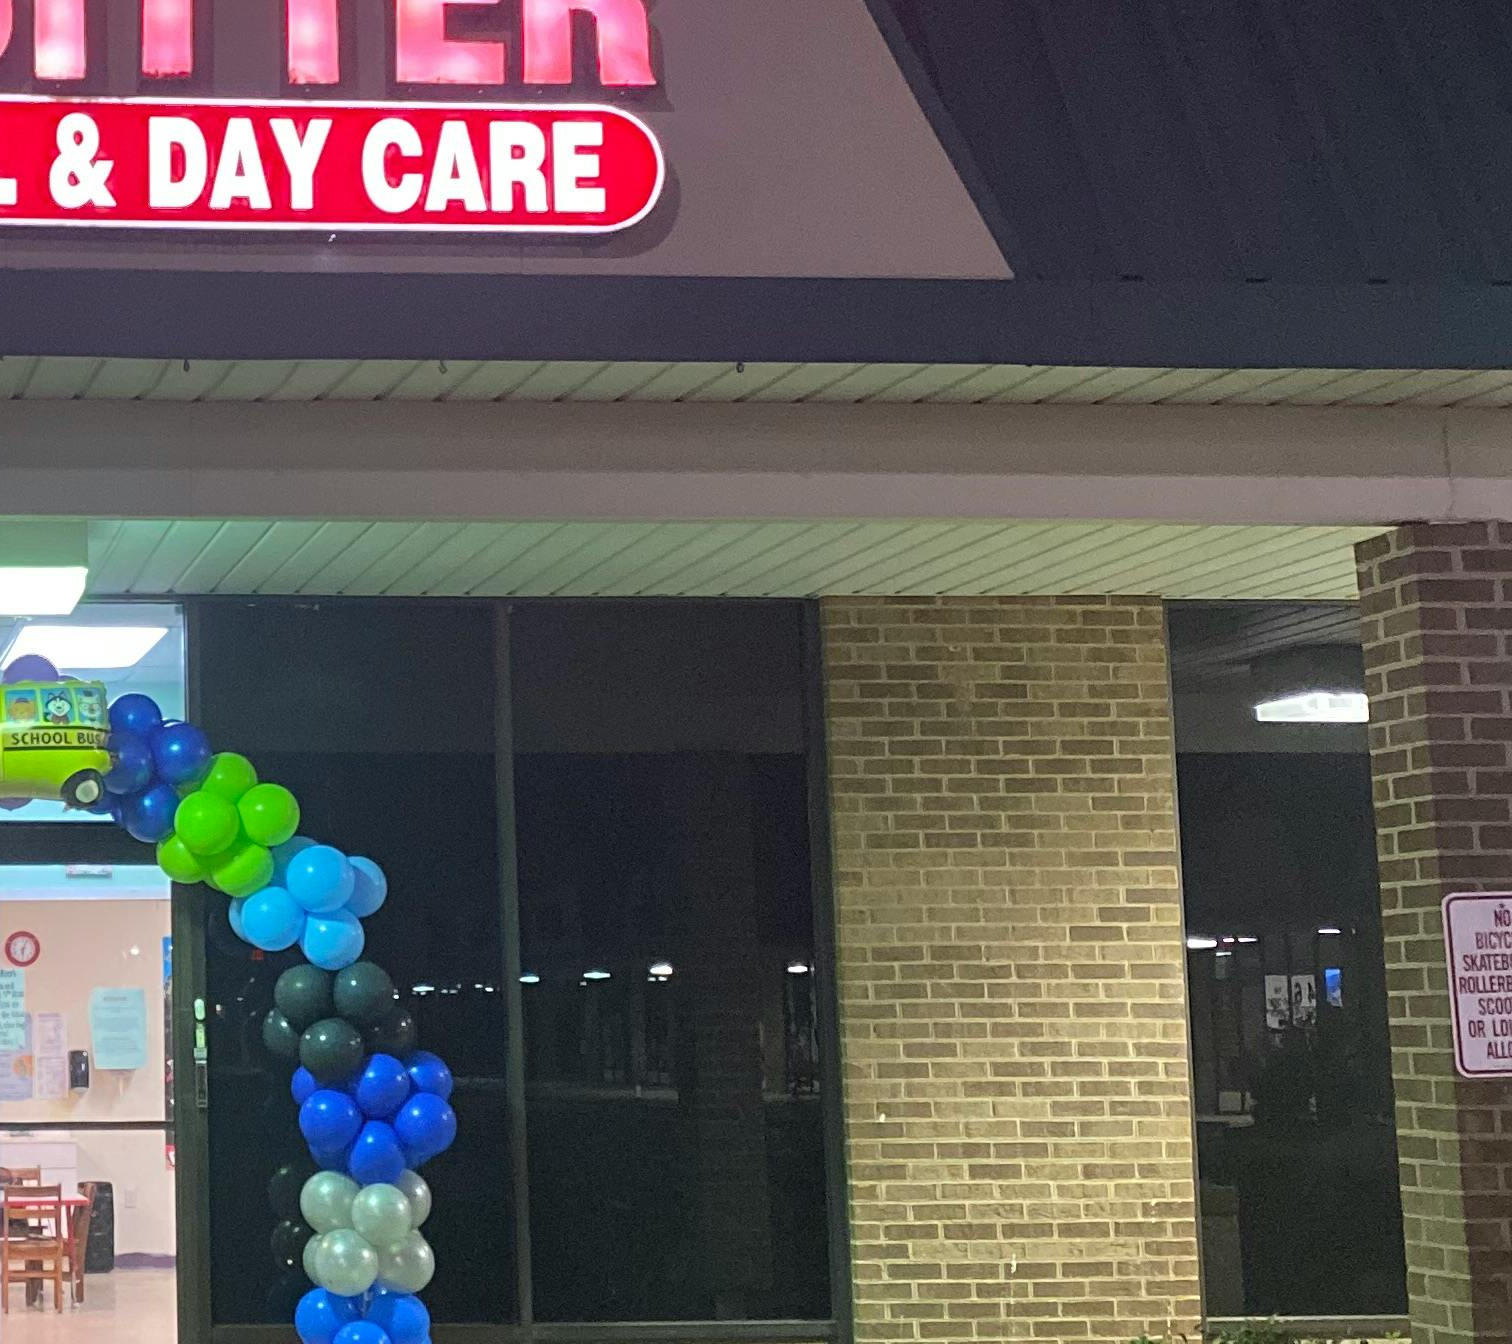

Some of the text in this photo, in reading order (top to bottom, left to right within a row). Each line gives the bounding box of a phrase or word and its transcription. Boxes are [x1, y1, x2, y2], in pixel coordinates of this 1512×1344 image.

[49, 113, 116, 209] &
[149, 116, 332, 210] DAY
[362, 118, 606, 213] CARE
[11, 732, 101, 745] SCHOOL BUS
[1494, 909, 1511, 927] NO
[1463, 953, 1512, 972] SKATEB
[1469, 1020, 1486, 1038] OR
